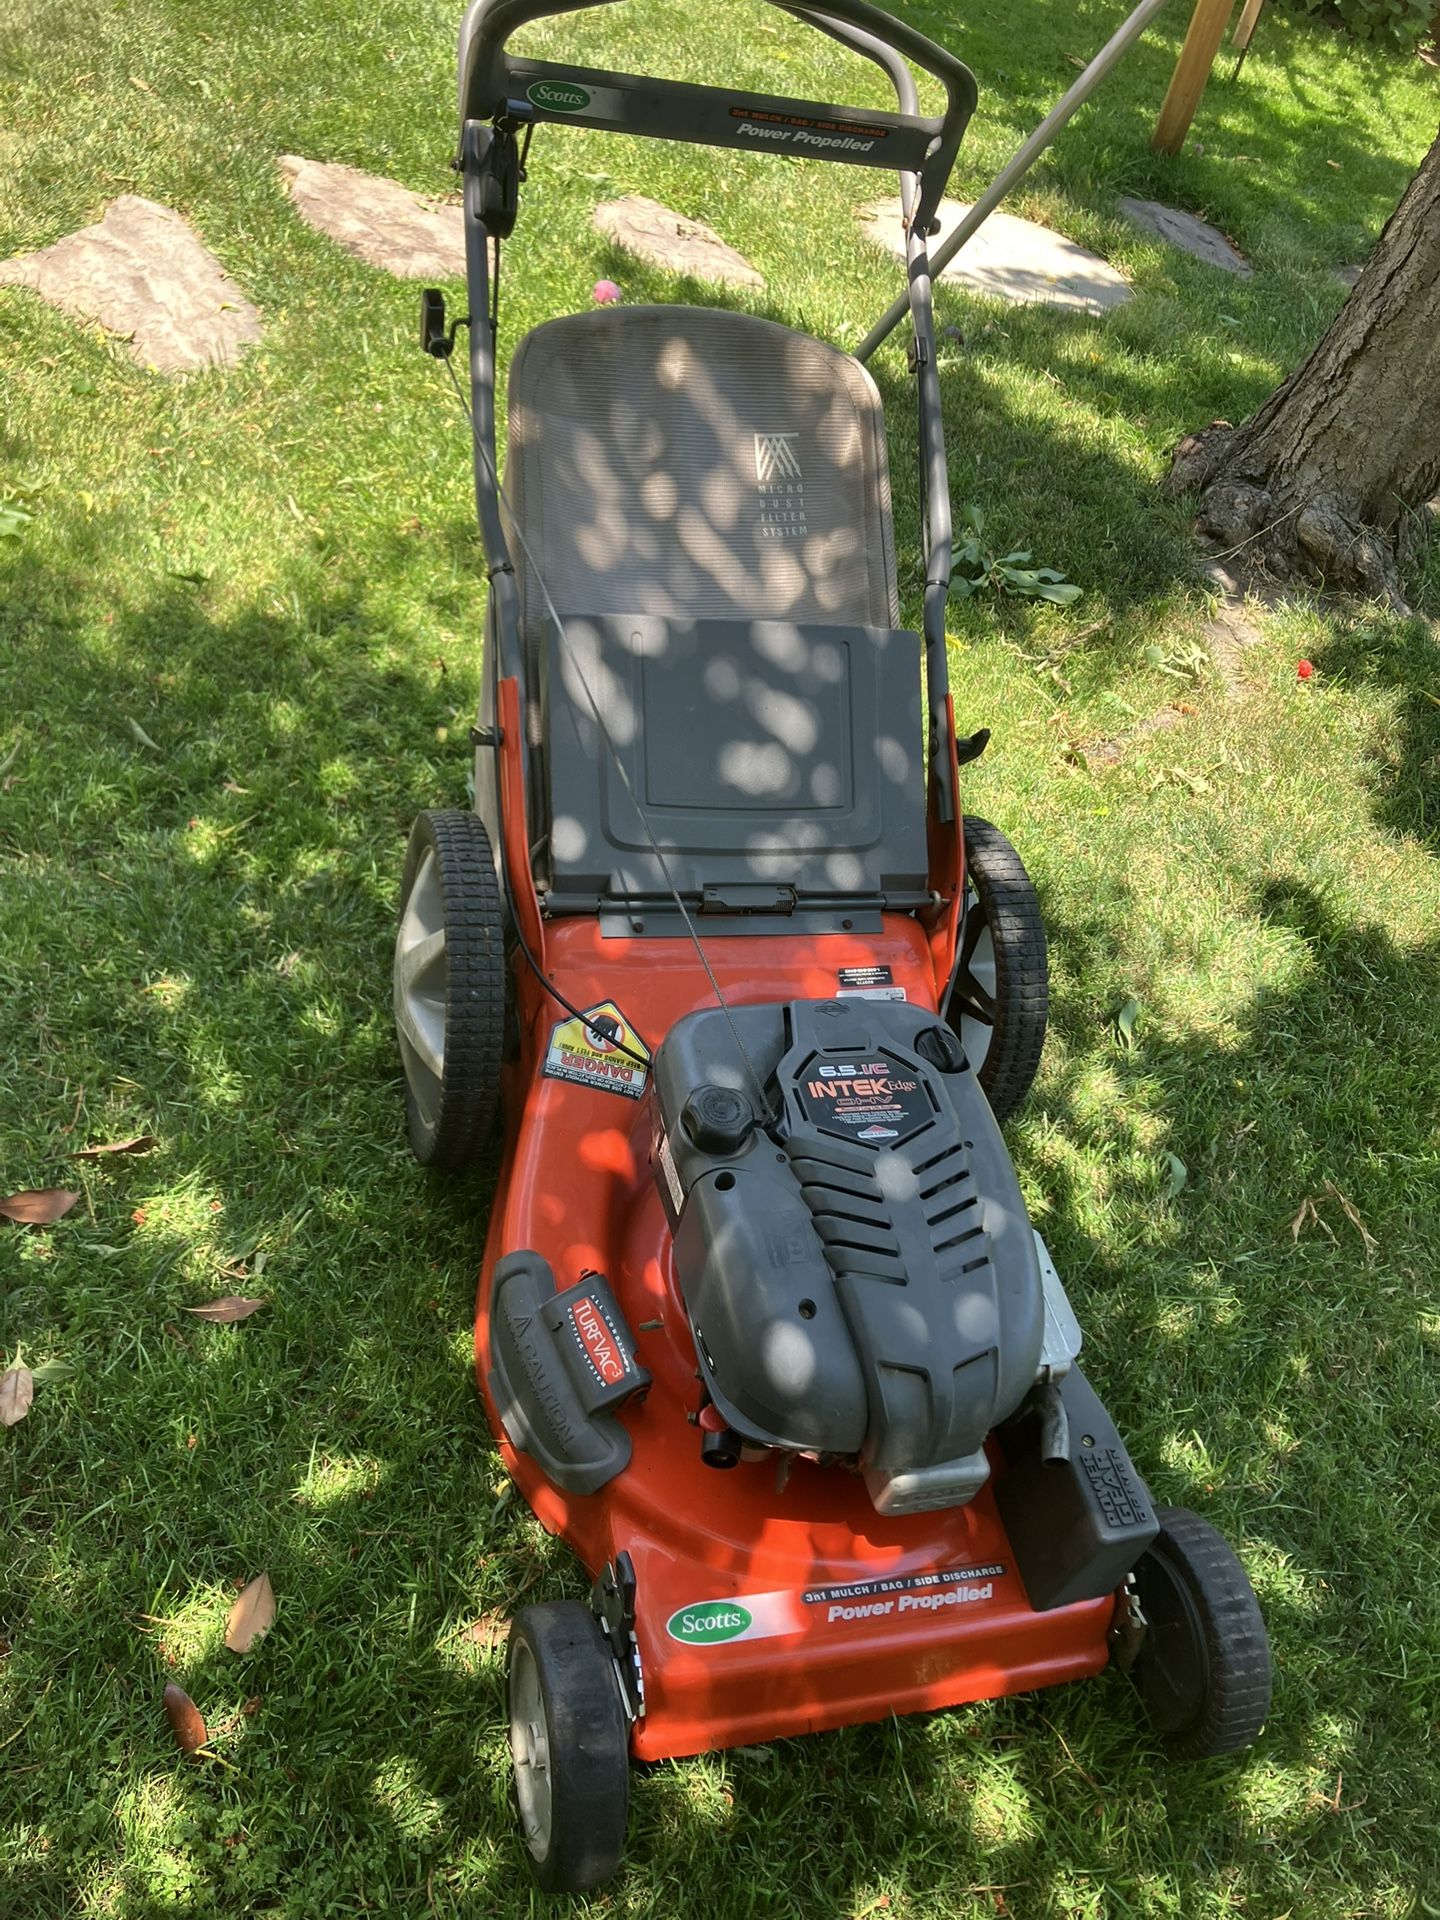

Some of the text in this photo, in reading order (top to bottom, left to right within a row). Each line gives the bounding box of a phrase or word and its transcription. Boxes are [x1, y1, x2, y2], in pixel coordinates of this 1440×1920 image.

[536, 85, 584, 105] Scotts
[736, 123, 875, 152] Power Propelled
[758, 484, 804, 494] MICRO
[759, 499, 804, 508] DUST
[760, 512, 806, 522] FILTER
[762, 526, 808, 537] SYSTEM
[576, 1047, 590, 1056] FEET
[604, 1055, 624, 1066] HANDS
[560, 1052, 634, 1082] DANGER
[819, 1064, 858, 1077] 6.5
[807, 1078, 918, 1099] INTEK Edge
[836, 1095, 893, 1106] OHV
[590, 1294, 603, 1311] ALL
[567, 1307, 607, 1388] CUTTING SYSTEM
[525, 1343, 575, 1447] CAUTION
[1080, 1455, 1122, 1528] POWER
[1092, 1453, 1136, 1525] GEAR
[805, 1591, 827, 1603] 3n1
[830, 1585, 870, 1599] MULCH
[881, 1580, 904, 1592] BAG
[914, 1575, 940, 1586] SIDE
[943, 1565, 1004, 1582] DISCHARGE
[827, 1583, 993, 1623] Power Propelled
[681, 1611, 742, 1634] Scotts
